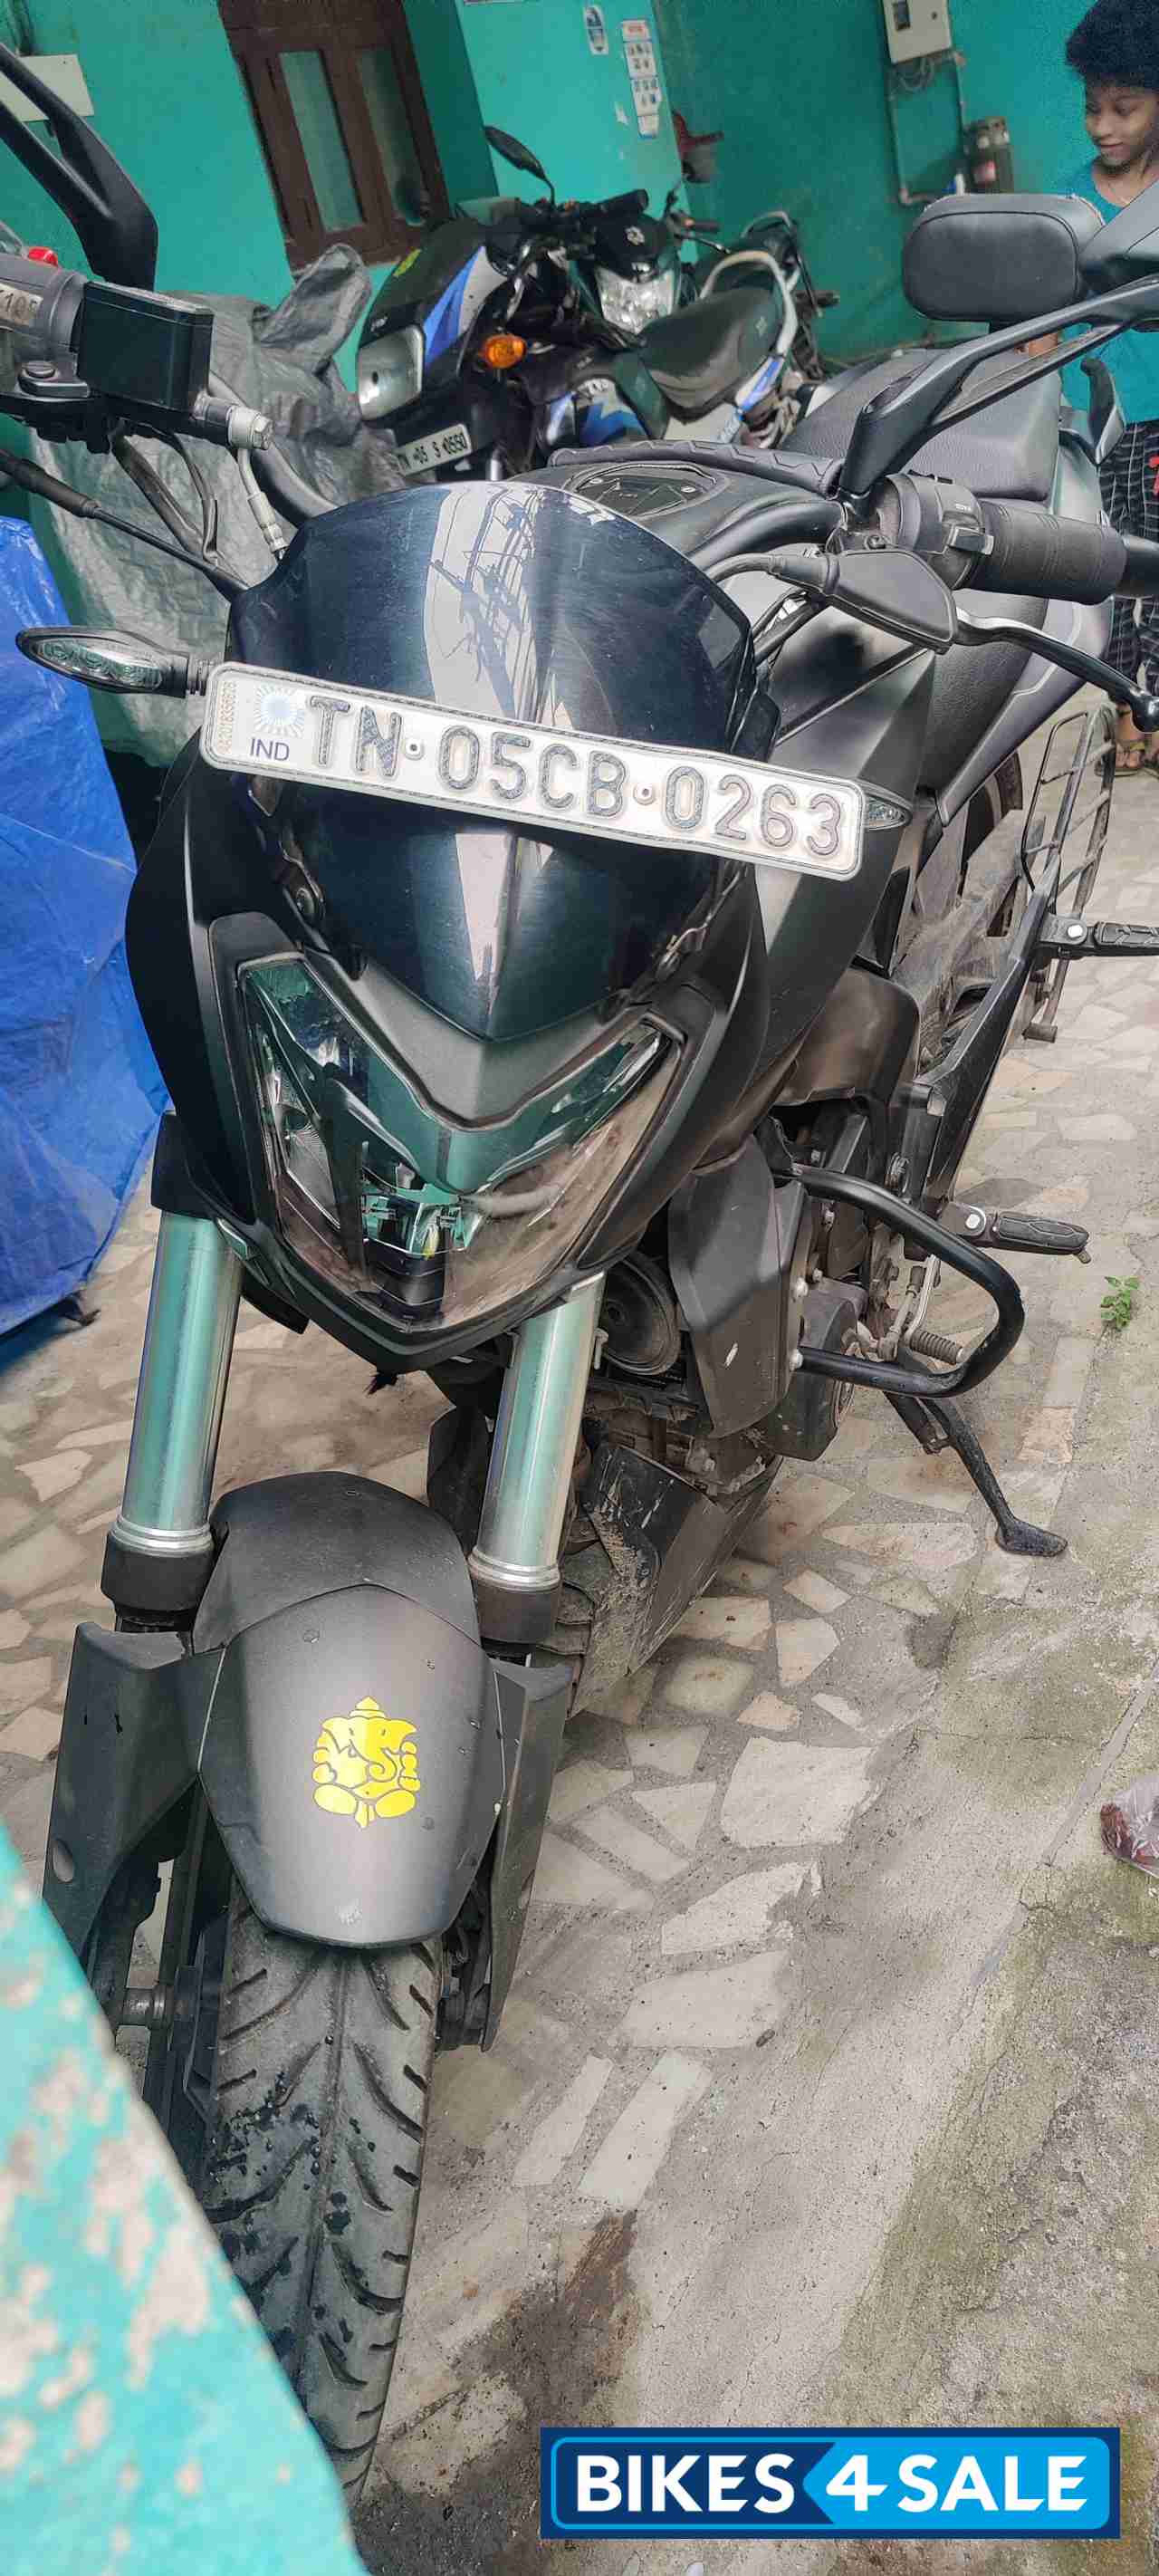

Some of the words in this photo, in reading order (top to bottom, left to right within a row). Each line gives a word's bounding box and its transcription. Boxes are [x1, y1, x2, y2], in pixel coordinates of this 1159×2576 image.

[250, 737, 290, 762] IND
[309, 695, 403, 777] TN
[438, 725, 627, 817] 05CB
[665, 765, 841, 856] 0263
